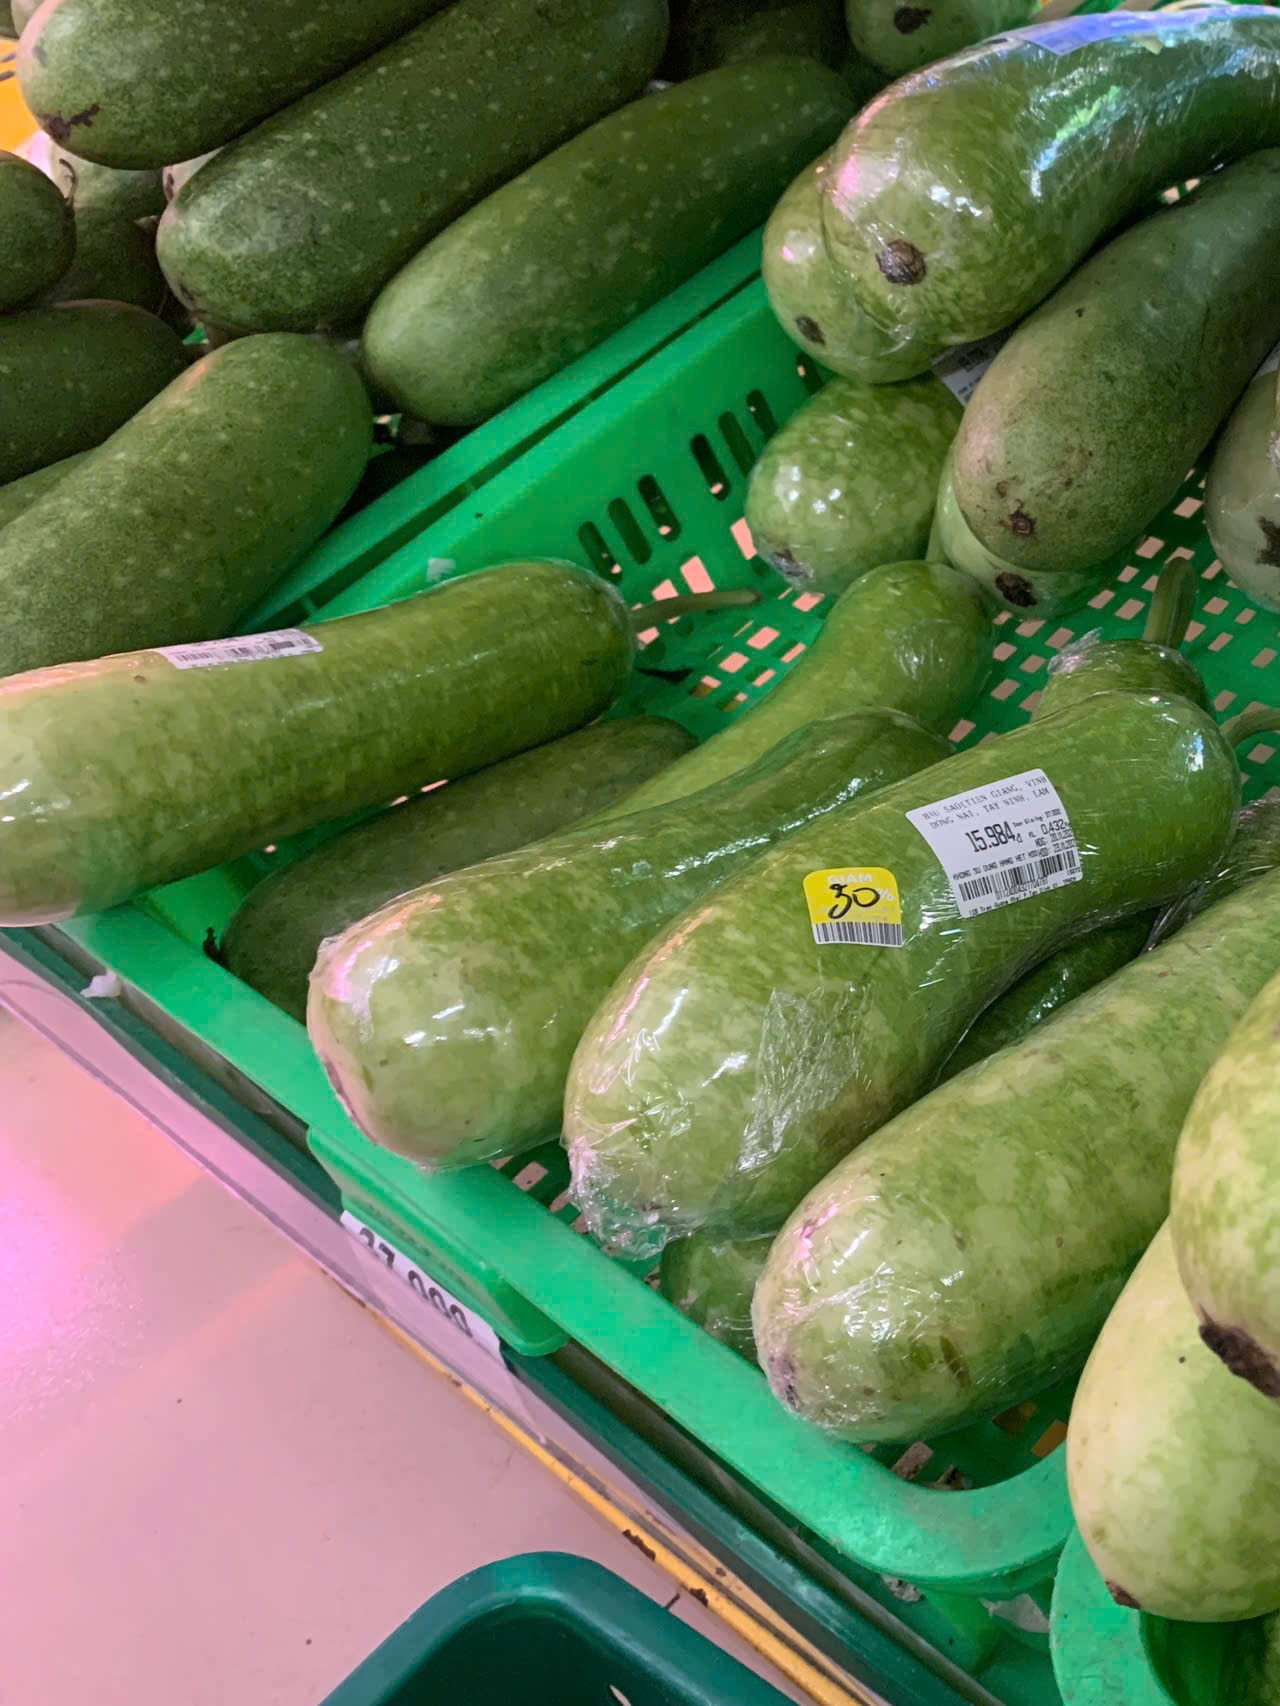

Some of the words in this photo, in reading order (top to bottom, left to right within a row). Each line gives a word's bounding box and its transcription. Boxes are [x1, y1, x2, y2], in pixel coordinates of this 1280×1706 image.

[984, 802, 999, 813] TAY
[965, 821, 1015, 853] 15.984
[828, 883, 881, 919] 30
